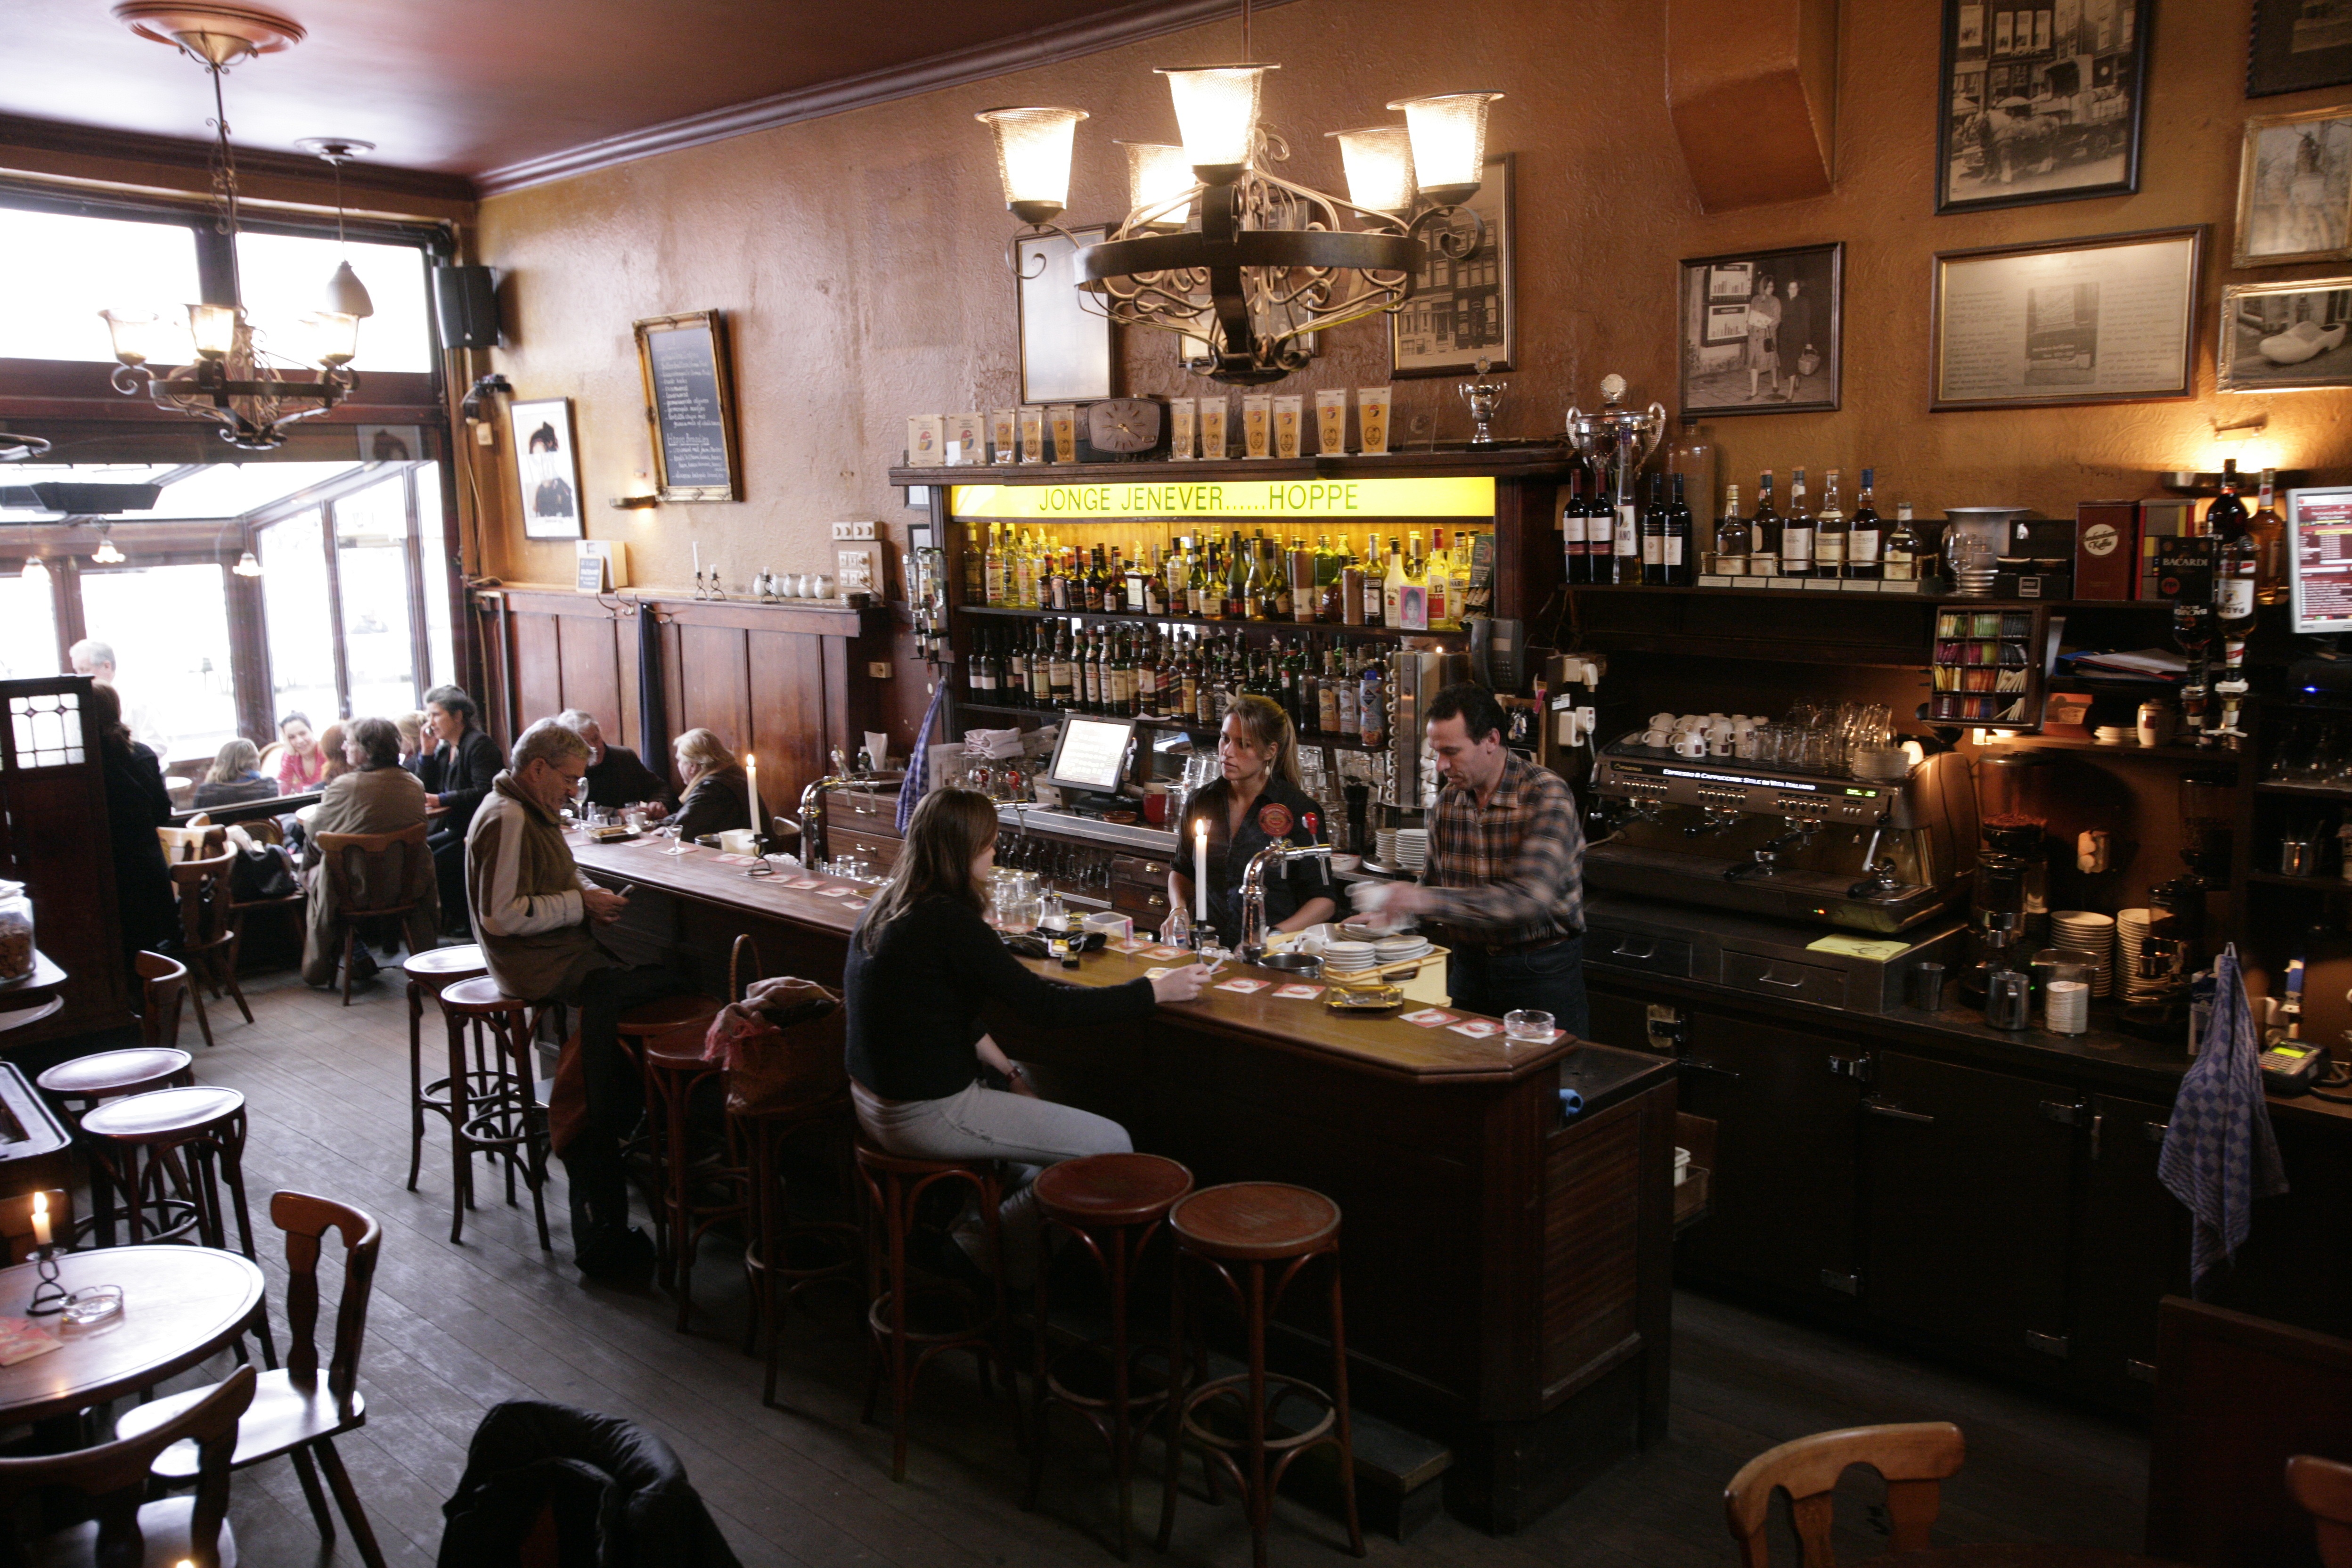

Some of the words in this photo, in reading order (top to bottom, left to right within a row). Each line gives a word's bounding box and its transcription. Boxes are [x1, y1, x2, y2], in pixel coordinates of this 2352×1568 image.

[1039, 488, 1110, 511] JONGE
[2163, 558, 2208, 566] BACARDI
[1433, 584, 1444, 593] 12
[1663, 768, 1695, 778] ESPRESSO
[1785, 782, 1815, 790] ITALIANO
